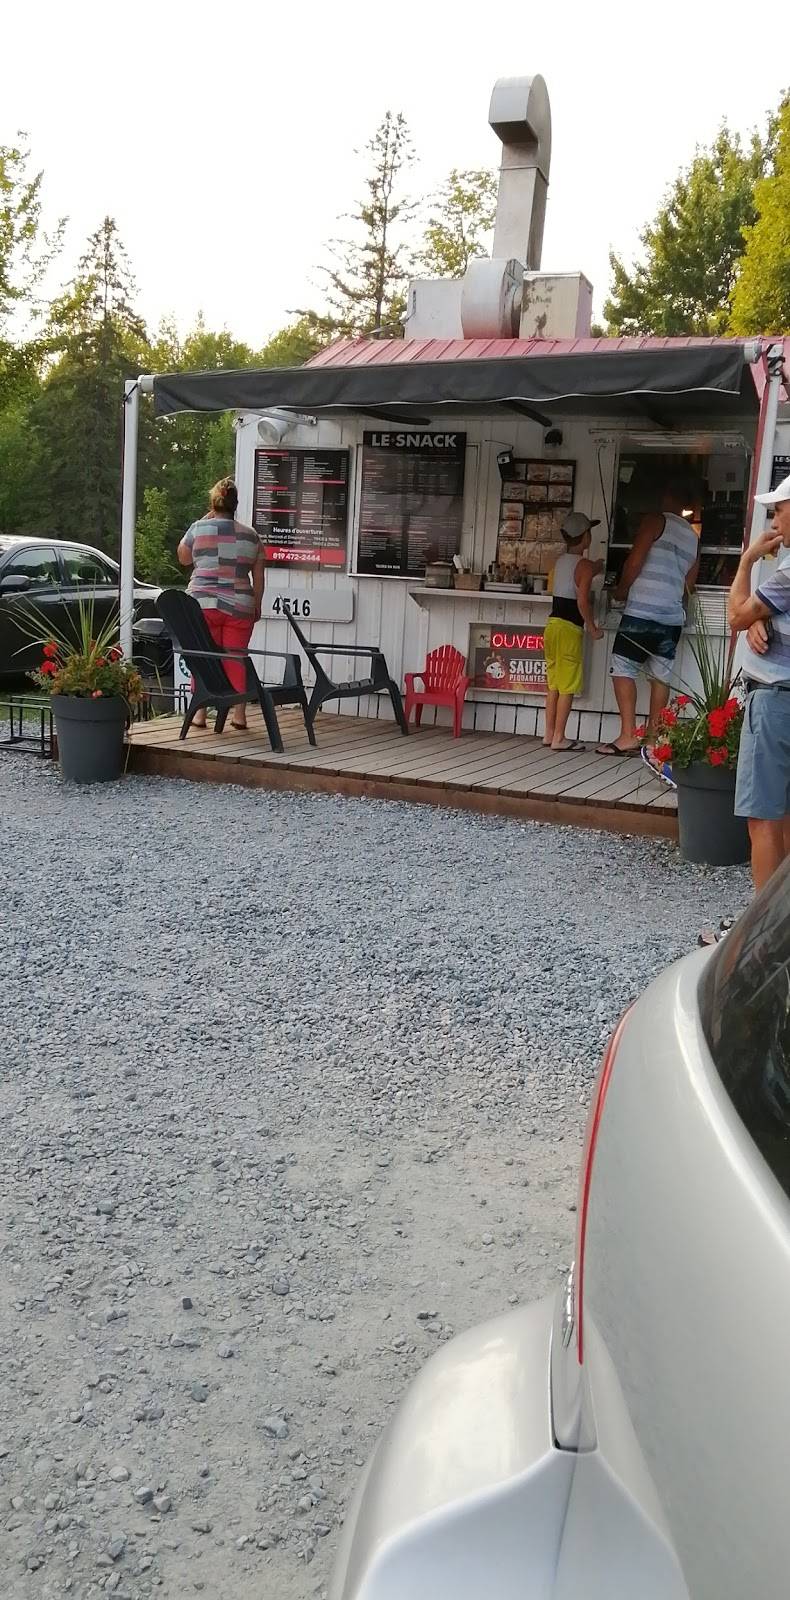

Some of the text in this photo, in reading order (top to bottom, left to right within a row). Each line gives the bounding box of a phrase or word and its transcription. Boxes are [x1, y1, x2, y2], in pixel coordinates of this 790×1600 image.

[371, 433, 457, 448] LE SNACK
[272, 597, 311, 617] 4516
[492, 633, 544, 649] OUVER
[509, 660, 547, 675] SAUCE
[509, 673, 546, 683] PIQUANTES
